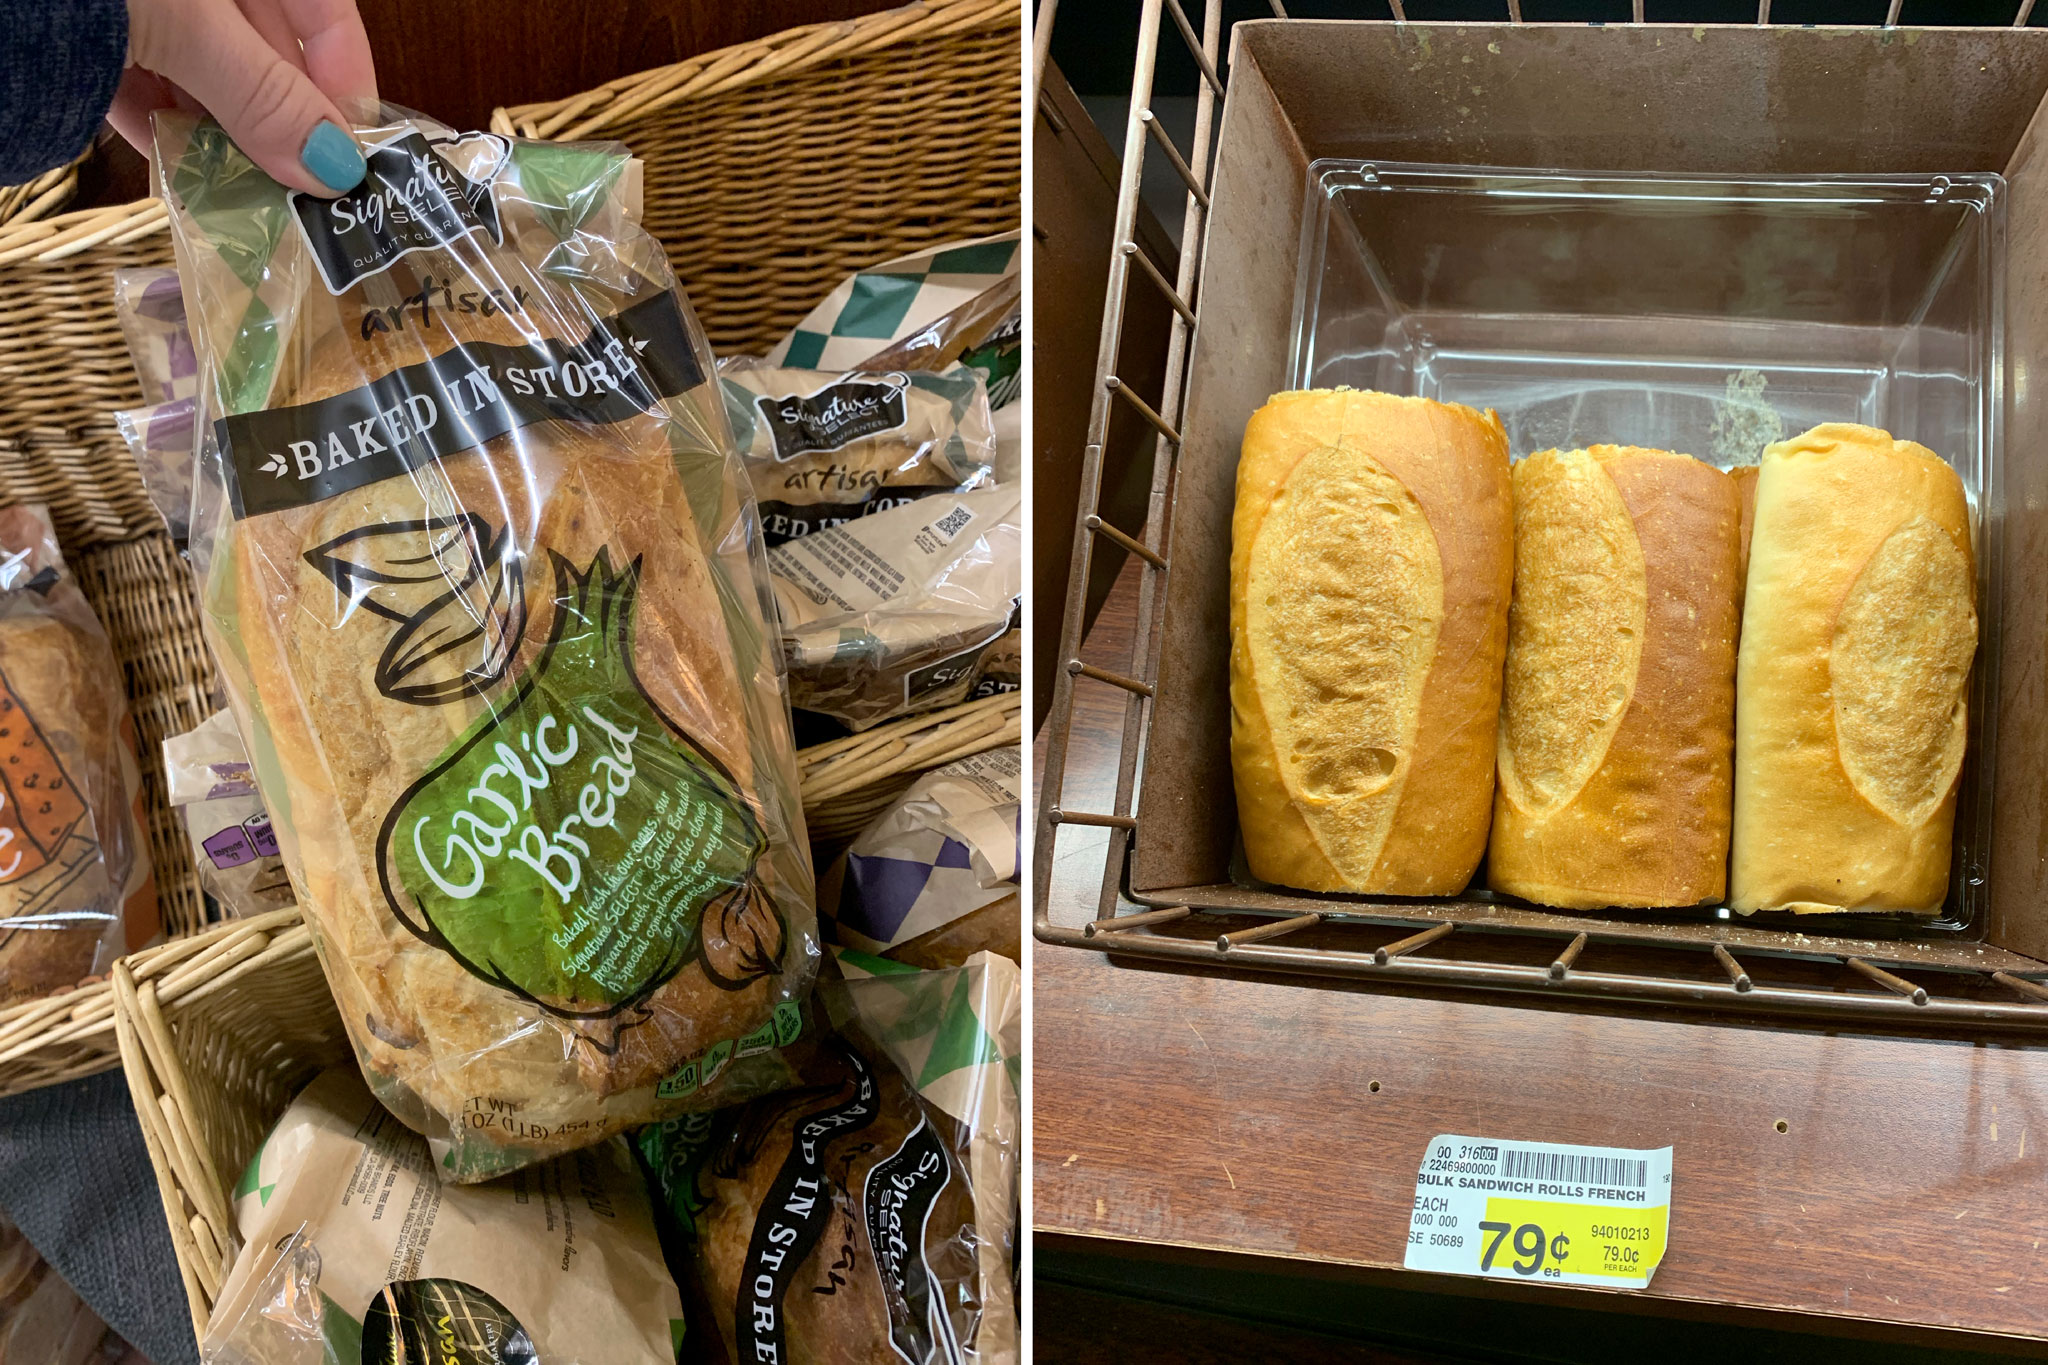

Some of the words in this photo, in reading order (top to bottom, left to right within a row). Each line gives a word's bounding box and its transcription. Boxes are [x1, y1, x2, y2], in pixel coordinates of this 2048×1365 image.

[331, 153, 456, 236] Signatu
[390, 187, 463, 225] SELE
[353, 233, 408, 269] QUALITY
[288, 395, 438, 481] BAKED
[447, 365, 499, 417] IN
[505, 338, 639, 399] STORE
[414, 716, 578, 899] Garlic
[509, 707, 637, 904] Bread
[553, 909, 589, 950] Baked
[580, 887, 610, 921] fresh
[655, 790, 669, 814] our
[561, 924, 612, 978] Signature
[643, 830, 676, 871] Garlic
[667, 787, 690, 831] Bread
[590, 930, 633, 987] prepared
[627, 903, 649, 931] with
[642, 872, 670, 902] fresh
[669, 837, 694, 879] garlic
[606, 978, 623, 993] A
[617, 936, 650, 982] special
[646, 874, 695, 938] complement
[690, 858, 705, 875] to
[702, 833, 723, 860] any
[663, 923, 673, 937] or
[488, 1097, 517, 1116] WT
[802, 1075, 872, 1165] BAKED
[472, 1113, 496, 1129] OZ
[520, 1122, 549, 1140] LB)
[555, 1120, 589, 1135] 454
[1429, 1159, 1496, 1176] 22469800000
[1437, 1146, 1452, 1159] 00
[784, 1177, 819, 1220] IN
[1417, 1173, 1454, 1187] BULK
[1458, 1178, 1534, 1194] SANDWICH
[1538, 1184, 1584, 1198] ROLLS
[1588, 1187, 1646, 1202] FRENCH
[1413, 1196, 1449, 1212] EACH
[1414, 1213, 1433, 1226] 000
[1439, 1215, 1458, 1228] 000
[1591, 1225, 1650, 1241] 94010213
[1430, 1234, 1464, 1247] 50689
[1603, 1245, 1640, 1263] 79.0¢
[1544, 1266, 1561, 1278] ea
[1604, 1263, 1617, 1272] PER
[1618, 1264, 1637, 1273] EACH
[753, 1222, 798, 1365] STORE
